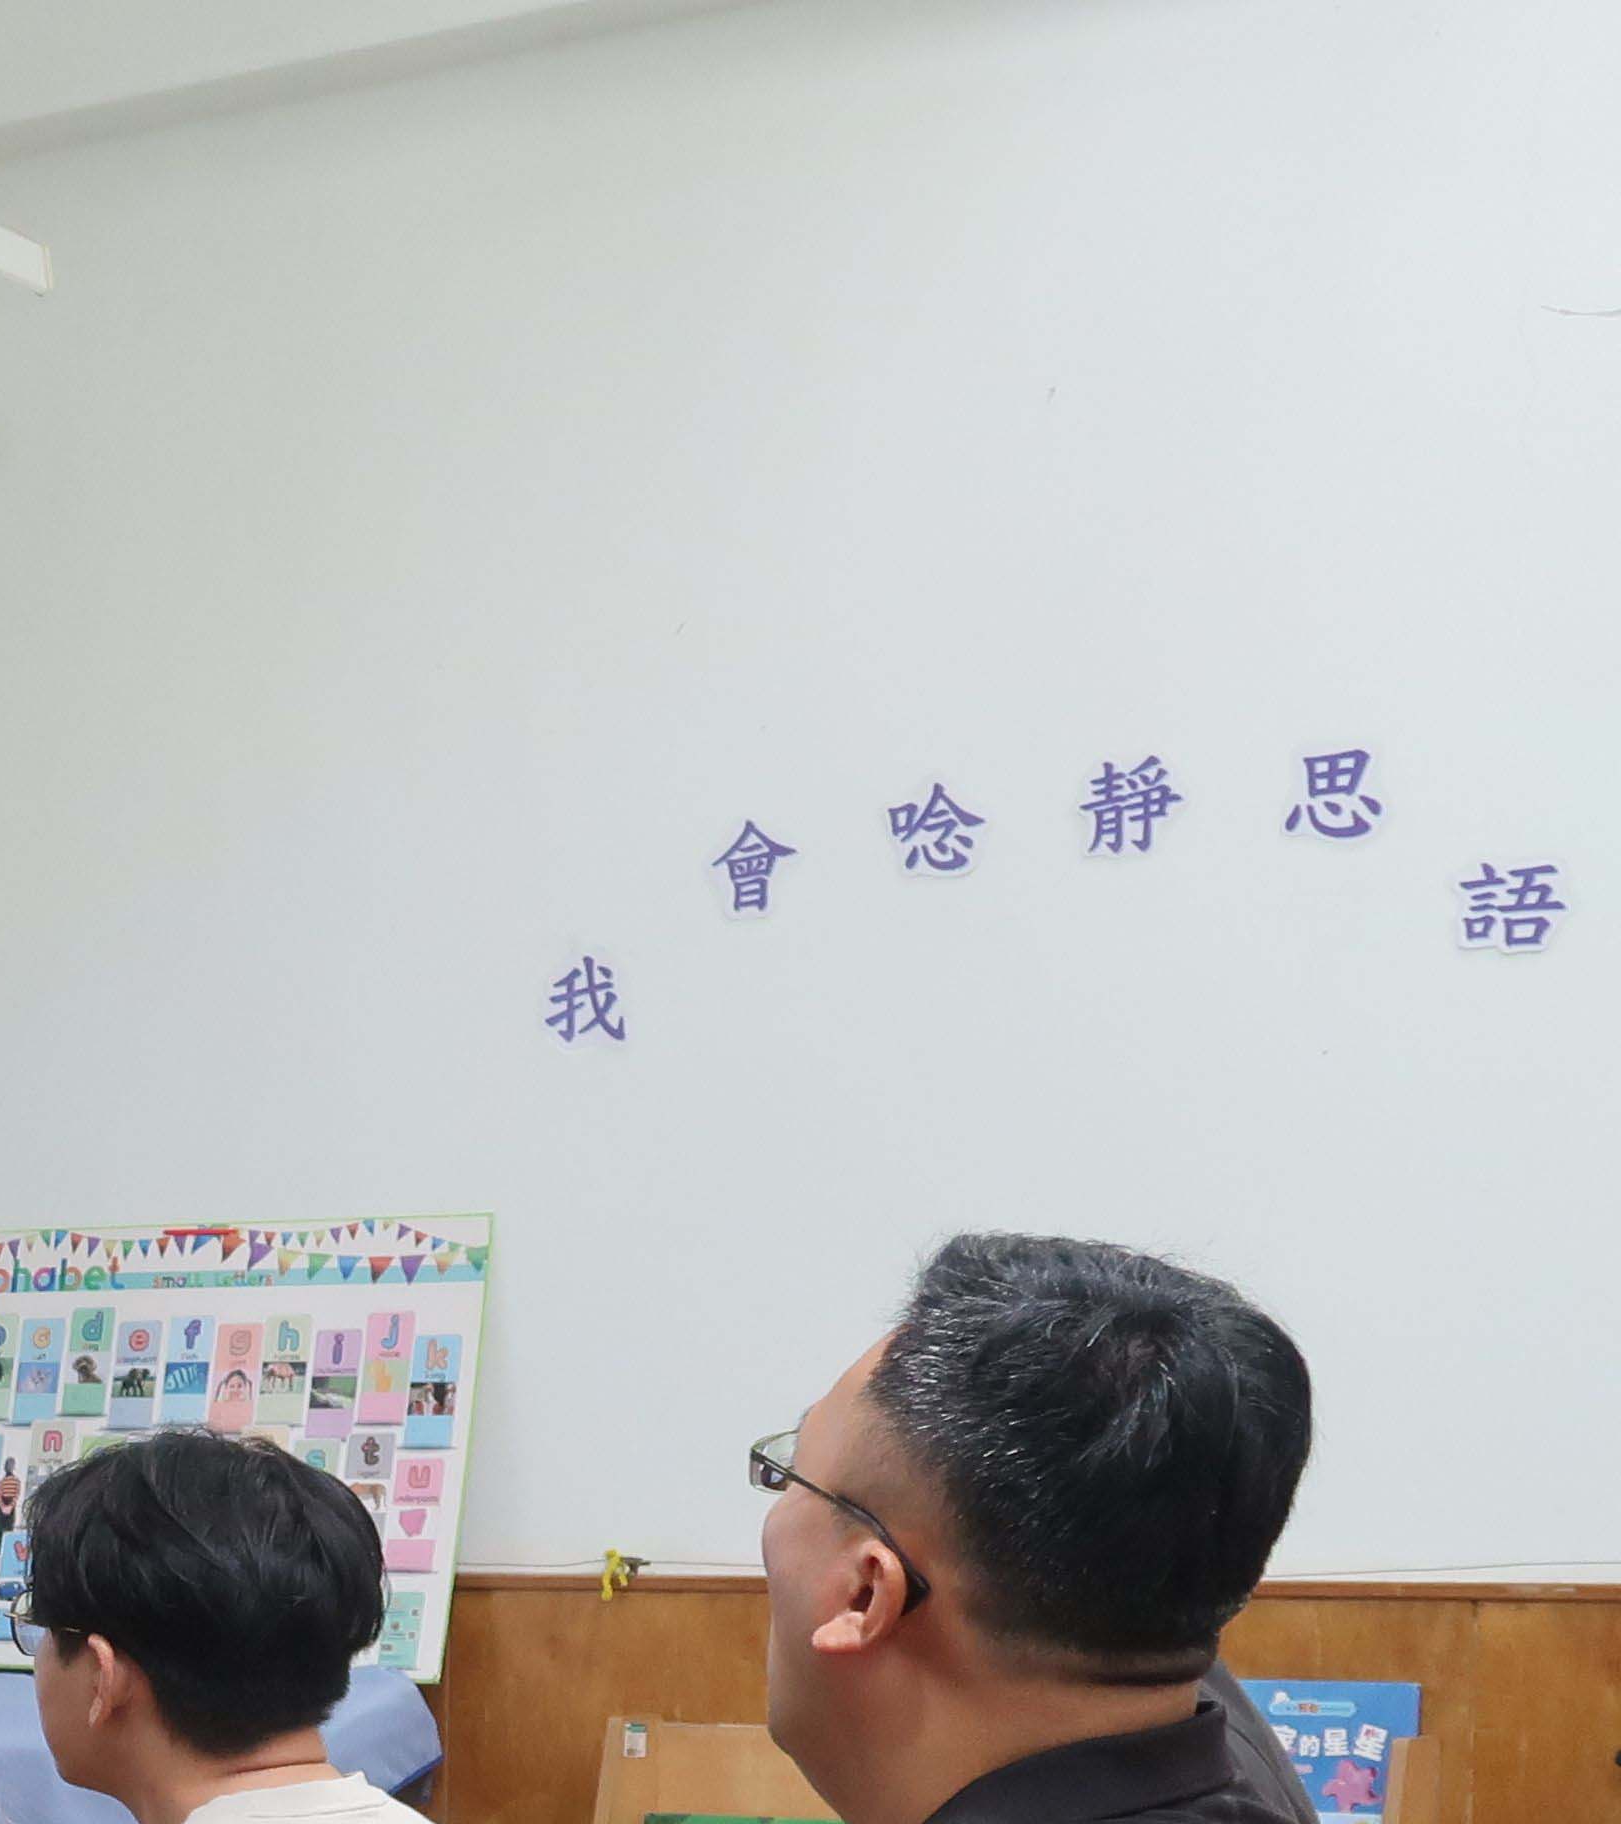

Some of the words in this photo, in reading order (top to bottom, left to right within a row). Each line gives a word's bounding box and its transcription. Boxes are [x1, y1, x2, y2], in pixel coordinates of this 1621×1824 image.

[82, 1310, 104, 1341] d
[129, 1329, 150, 1351] e
[184, 1319, 202, 1350] f
[278, 1320, 300, 1351] h
[229, 1330, 252, 1356] g
[332, 1333, 345, 1365] i
[426, 1338, 449, 1370] k
[43, 1430, 63, 1452] n
[361, 1436, 380, 1466] t
